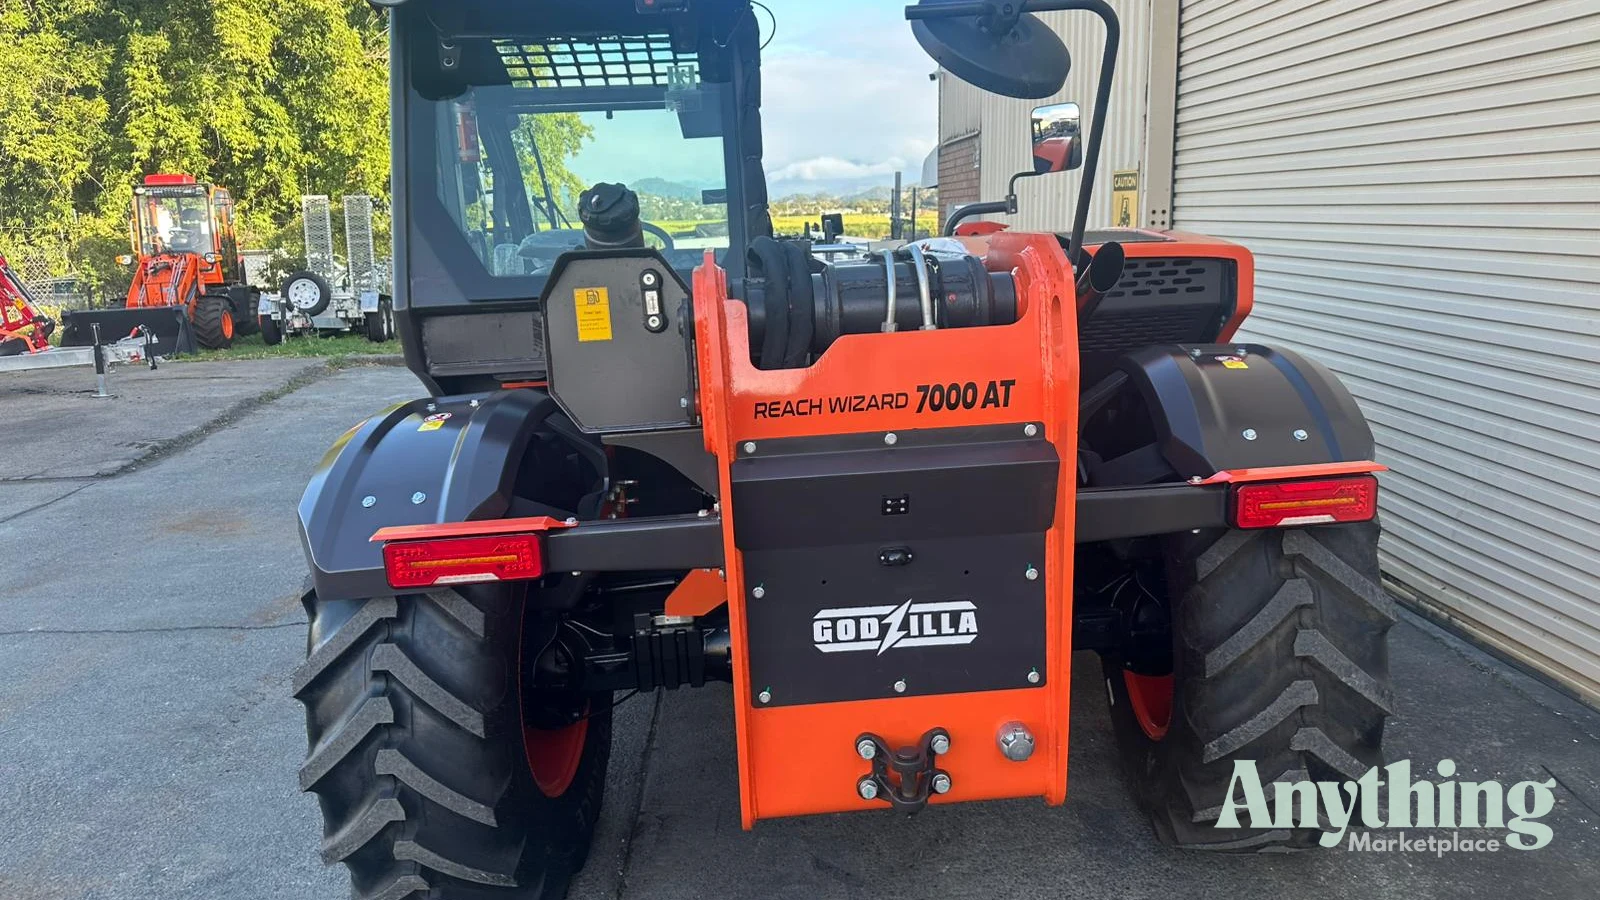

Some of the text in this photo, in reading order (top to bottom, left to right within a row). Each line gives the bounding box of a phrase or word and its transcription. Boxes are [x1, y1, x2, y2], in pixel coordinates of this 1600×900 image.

[1114, 176, 1137, 188] CAUTION
[754, 379, 1016, 419] REACH WIZARD 7000 AT
[812, 598, 978, 657] GODZILLA
